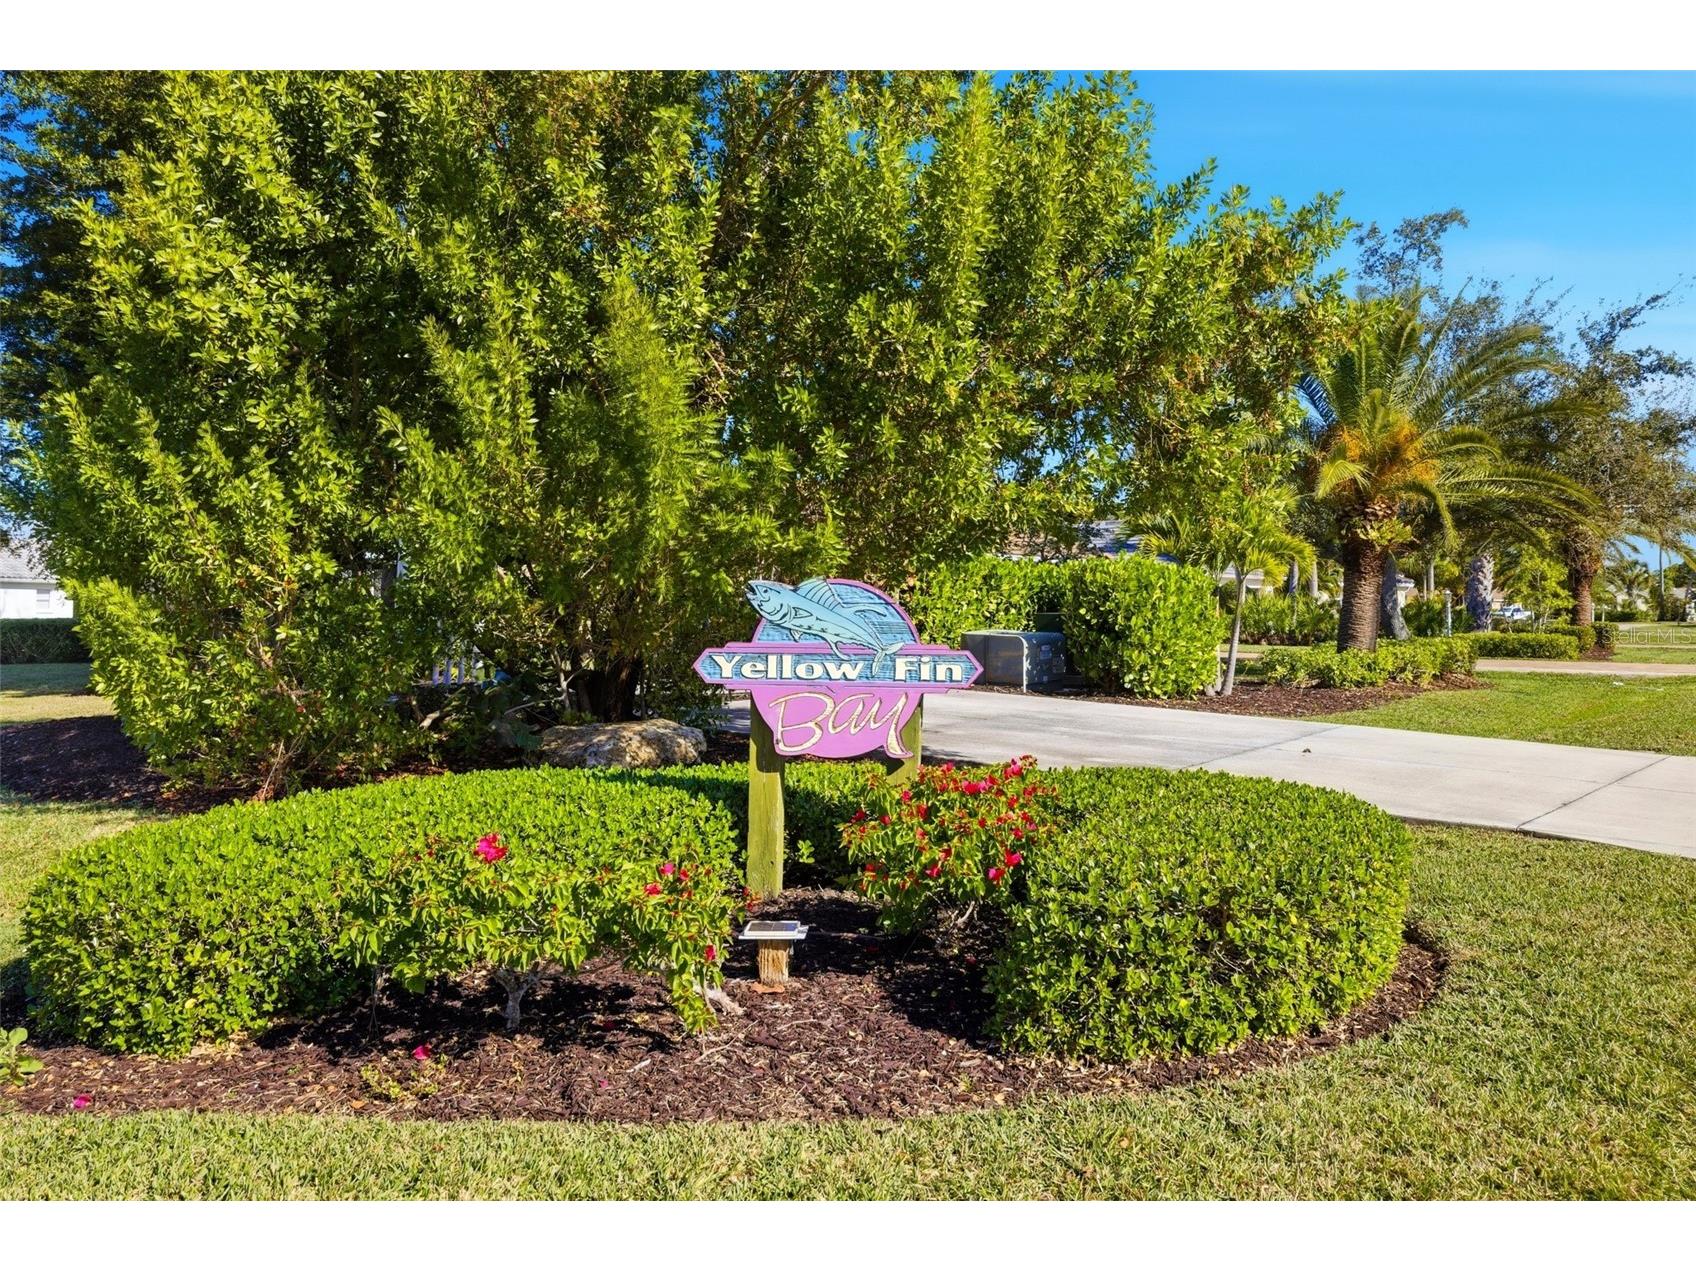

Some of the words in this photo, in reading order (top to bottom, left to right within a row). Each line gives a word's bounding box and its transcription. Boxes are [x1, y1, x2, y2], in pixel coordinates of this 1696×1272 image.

[710, 653, 865, 680] Yellow
[894, 656, 963, 682] Fin
[768, 691, 909, 755] Bay
